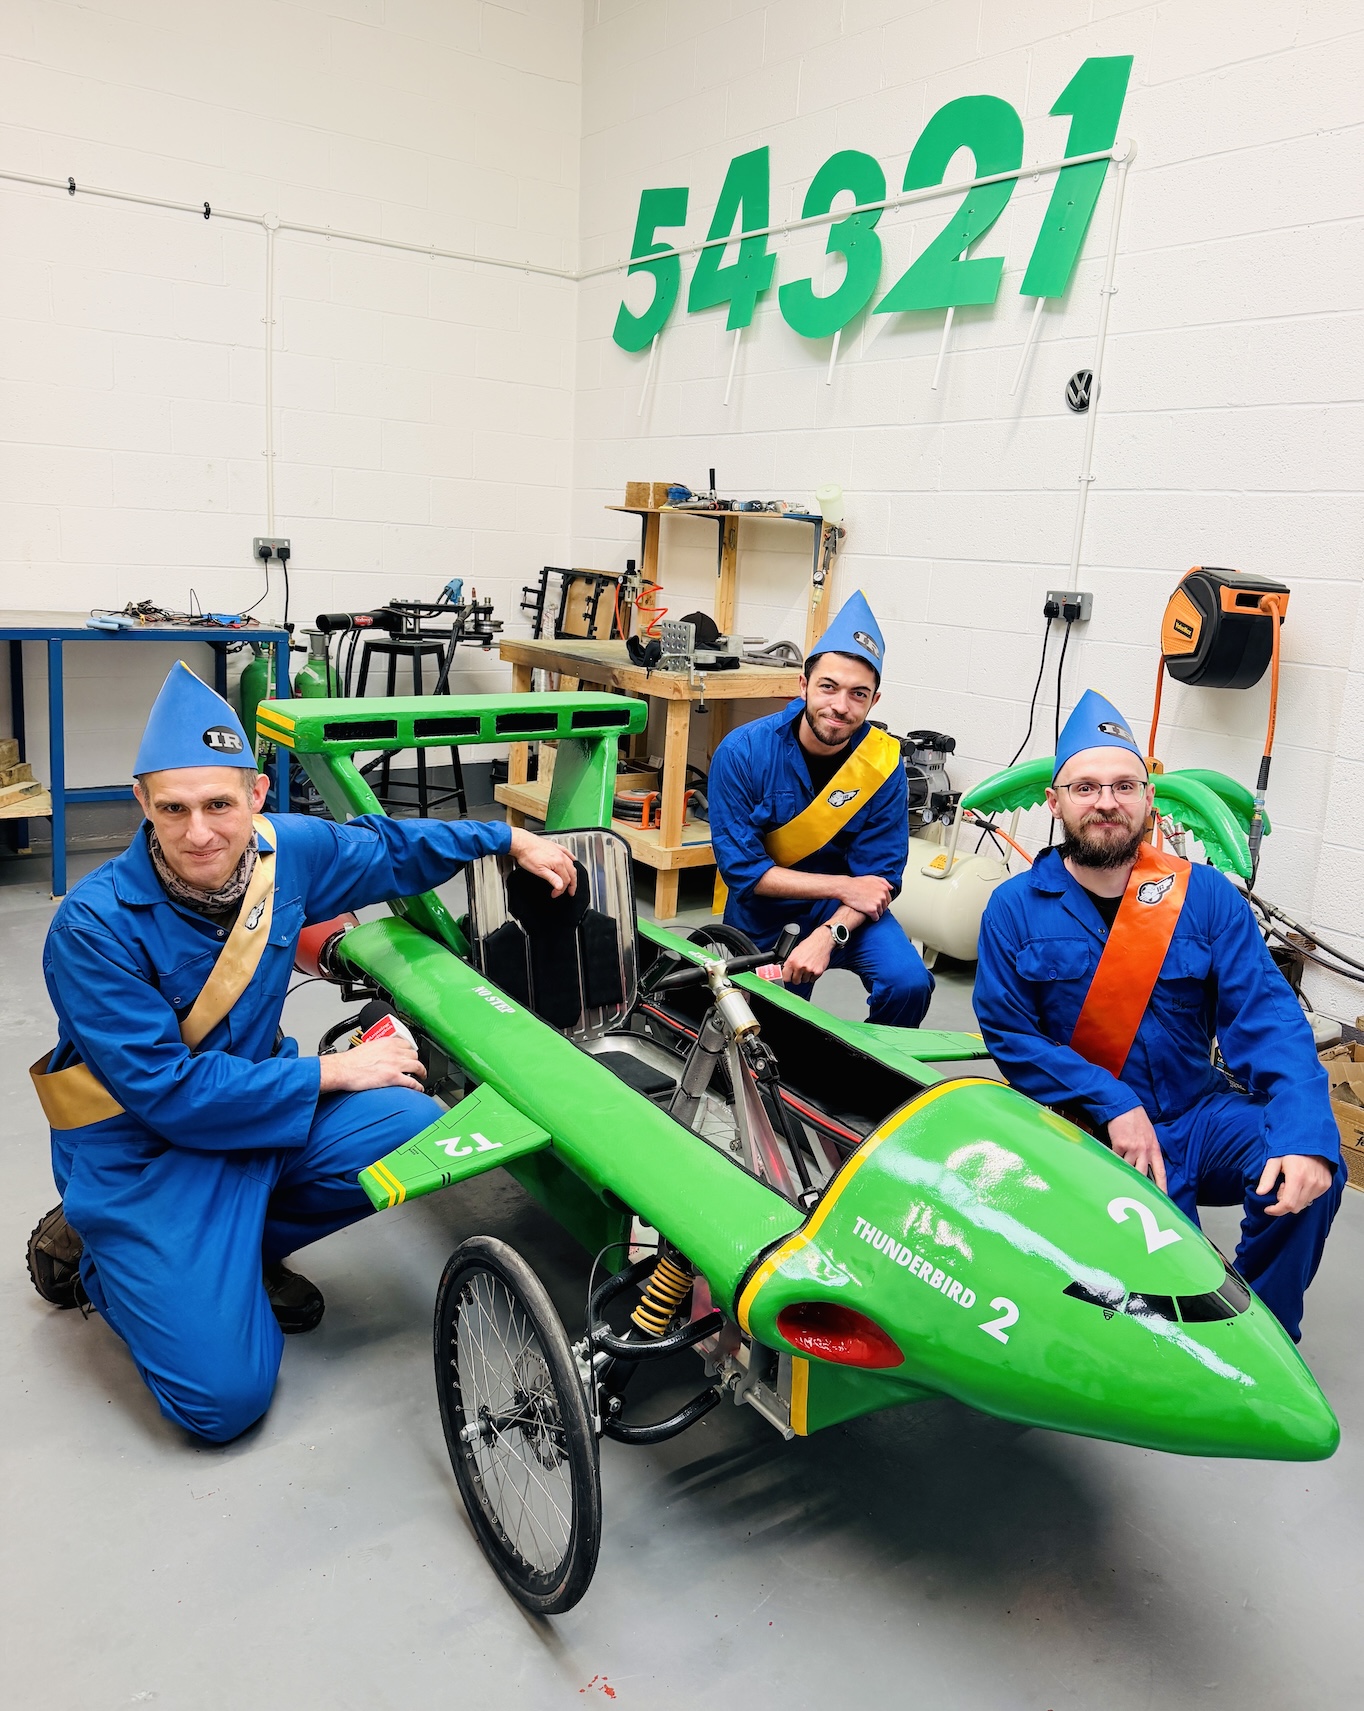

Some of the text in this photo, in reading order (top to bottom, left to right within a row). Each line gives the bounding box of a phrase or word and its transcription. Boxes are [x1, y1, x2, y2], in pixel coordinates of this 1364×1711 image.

[612, 55, 1134, 353] 54321
[856, 632, 880, 659] IR
[207, 731, 243, 750] IR
[471, 985, 517, 1014] NO STEP
[434, 1132, 504, 1157] T2
[1107, 1196, 1183, 1255] 2
[852, 1215, 1020, 1345] THUNDERBIRD 2
